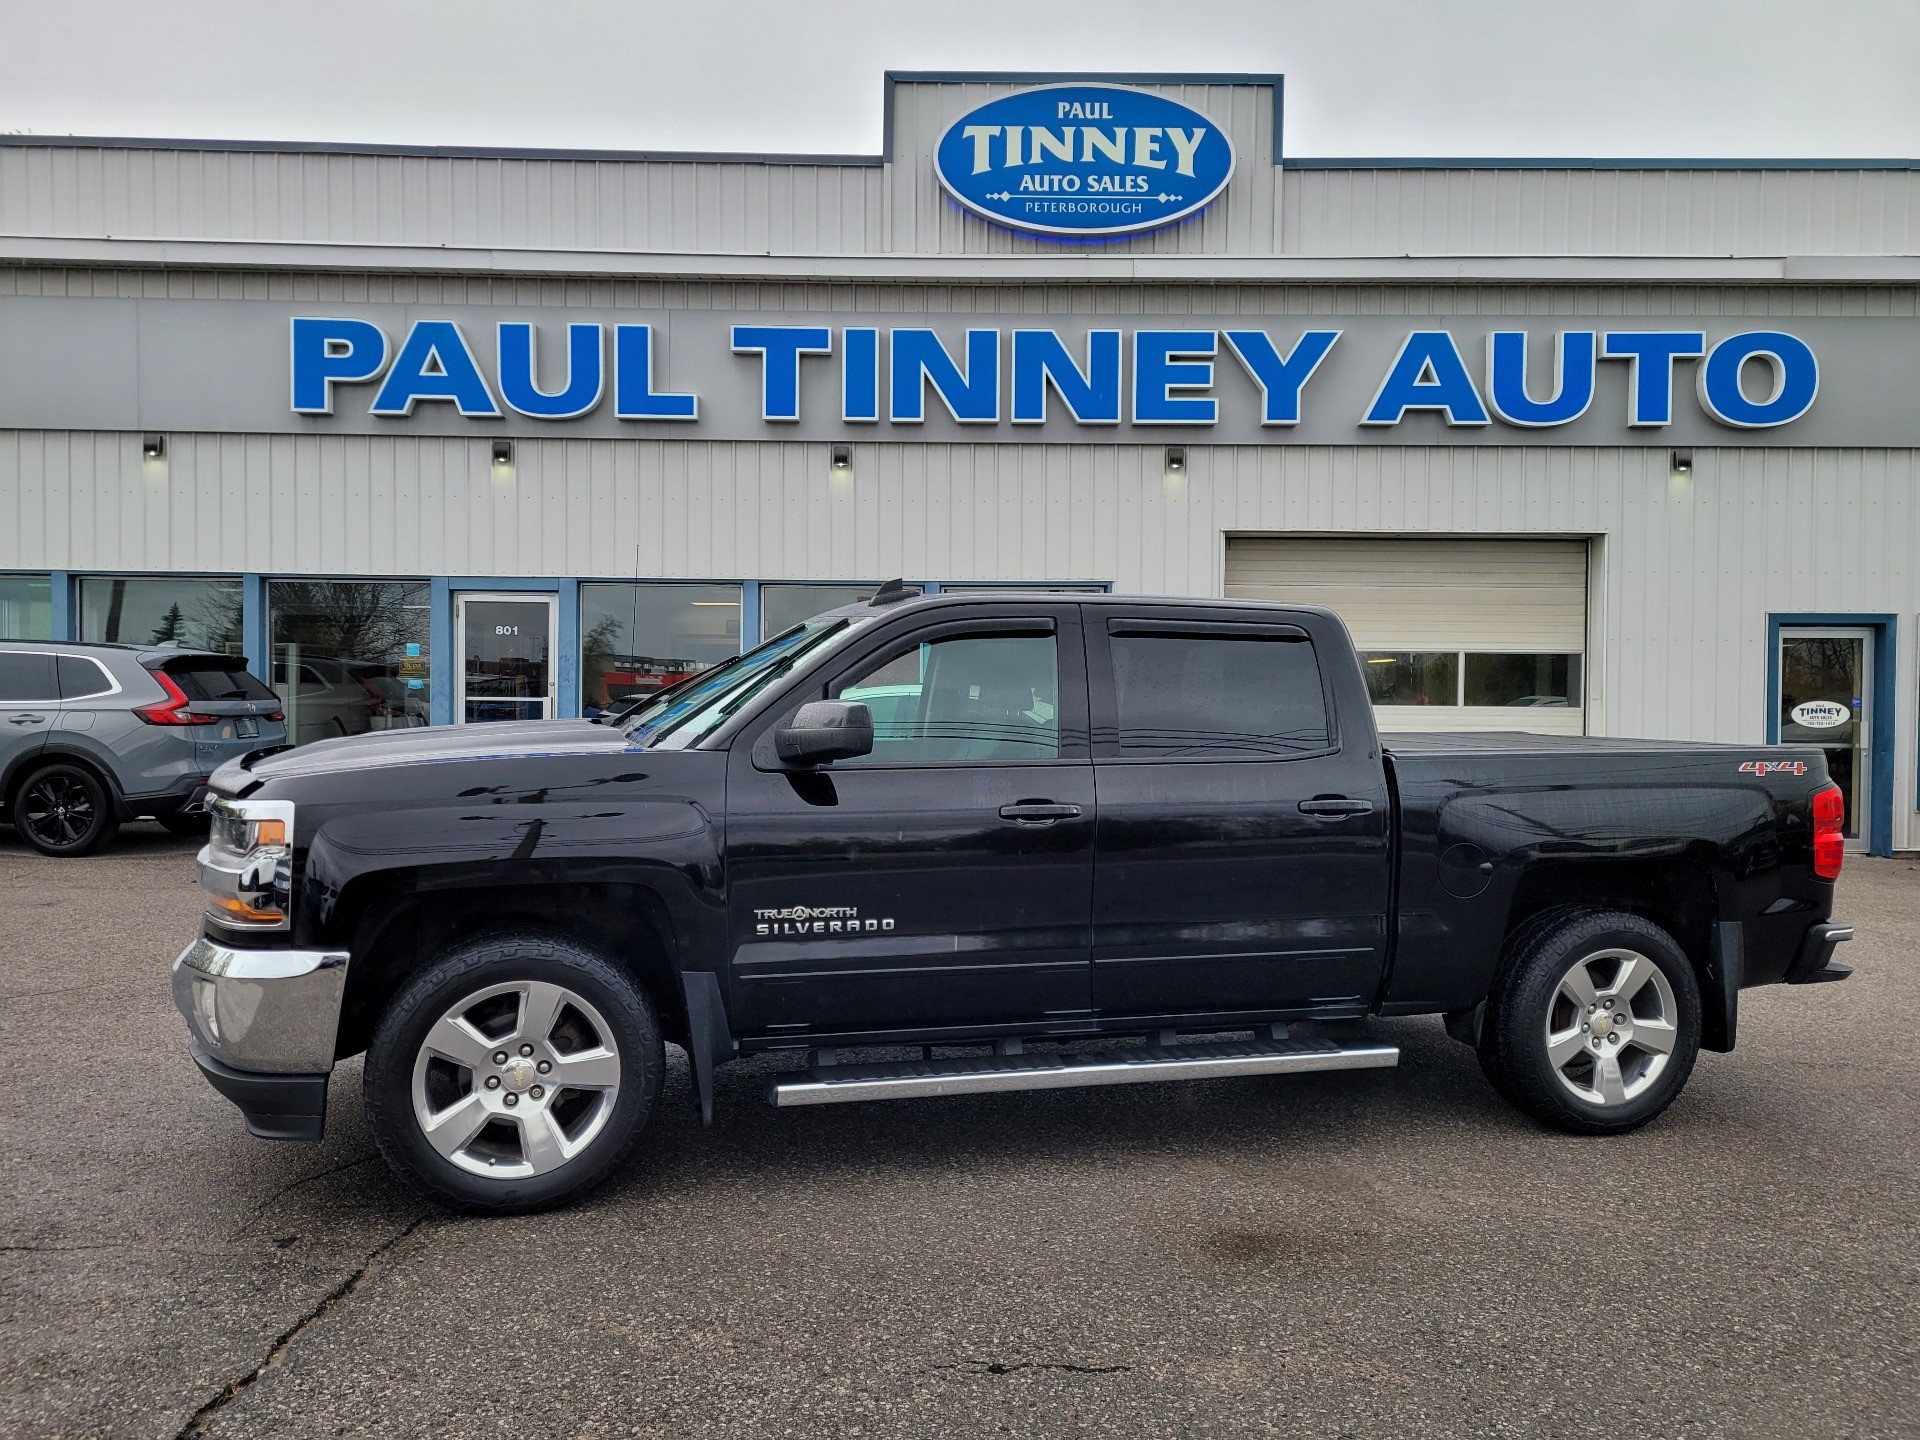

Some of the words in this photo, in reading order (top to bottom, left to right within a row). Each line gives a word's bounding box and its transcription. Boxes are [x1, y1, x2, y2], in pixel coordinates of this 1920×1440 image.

[1057, 102, 1113, 119] PAUL
[962, 125, 1207, 178] TINNEY
[1018, 175, 1080, 192] AUTO
[1087, 175, 1149, 192] SALES
[1025, 201, 1143, 214] PETERBOROUGH
[290, 316, 699, 421] PAUL
[730, 324, 1344, 426] TINNEY
[1357, 329, 1820, 430] AUTO
[495, 625, 518, 636] 801
[1799, 708, 1842, 717] TINNEY
[754, 909, 794, 920] TRUE
[805, 907, 858, 918] NORTH
[756, 918, 895, 936] SILVERADO
